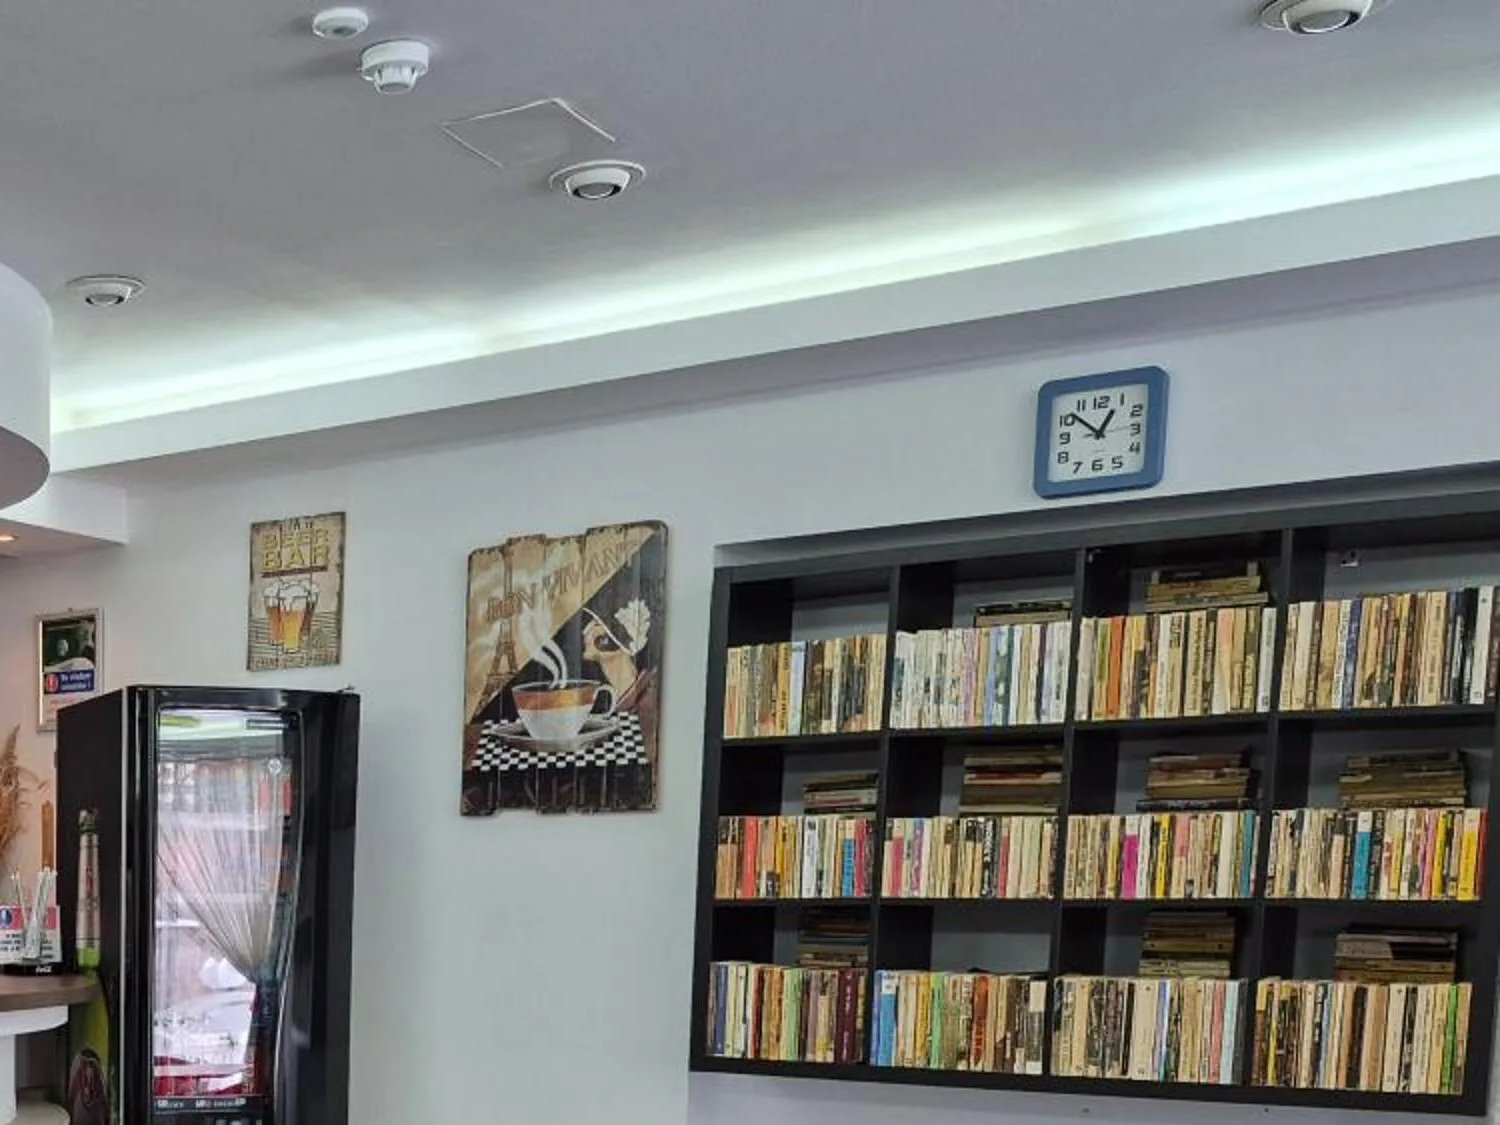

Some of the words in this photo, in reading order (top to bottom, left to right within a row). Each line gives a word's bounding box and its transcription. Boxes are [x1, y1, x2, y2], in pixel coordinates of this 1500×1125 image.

[1077, 400, 1087, 412] 11
[1092, 395, 1111, 411] 12
[1119, 392, 1125, 406] 1
[1130, 404, 1143, 417] 2
[1059, 413, 1076, 428] 10
[1130, 423, 1141, 437] 3
[1059, 432, 1071, 445] 9
[1129, 442, 1141, 454] 4
[1057, 451, 1069, 464] 8
[1073, 461, 1083, 474] 7
[1091, 460, 1104, 472] 6
[1111, 456, 1124, 469] 5
[262, 545, 329, 571] BAR
